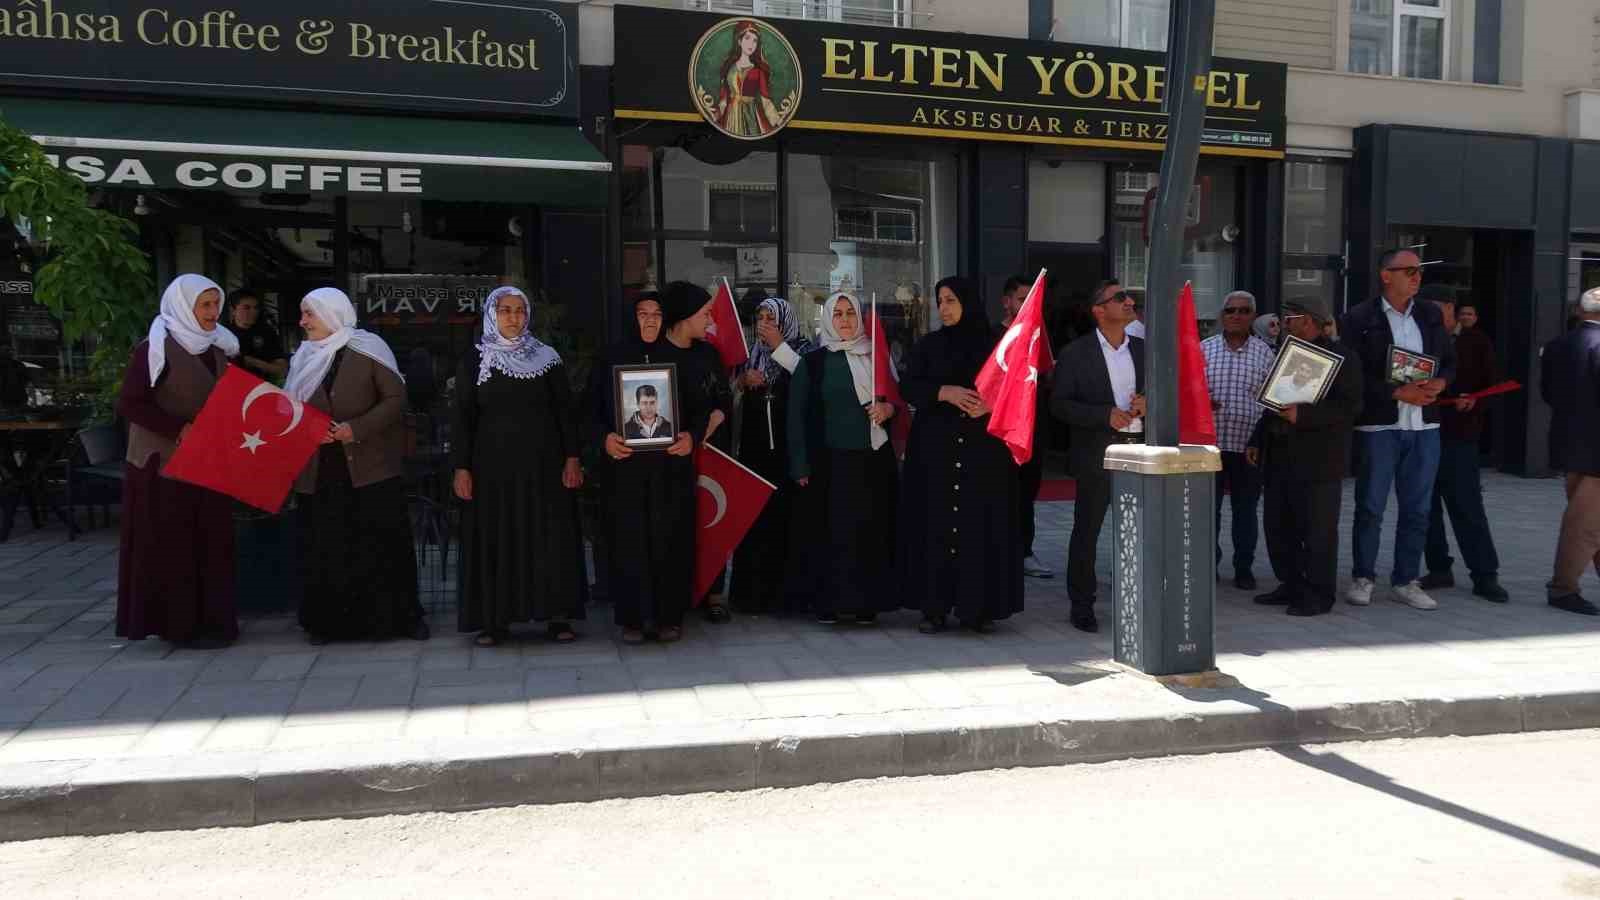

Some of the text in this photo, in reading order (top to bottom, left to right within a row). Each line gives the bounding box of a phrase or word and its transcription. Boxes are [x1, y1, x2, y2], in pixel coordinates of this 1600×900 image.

[137, 8, 281, 51] Coffee
[295, 19, 335, 55] &
[348, 22, 540, 71] Breakfast
[821, 37, 1262, 111] ELTEN YÖREEL
[911, 106, 1169, 141] AKSESUAR & TERZ
[44, 154, 423, 193] SA COFFEE
